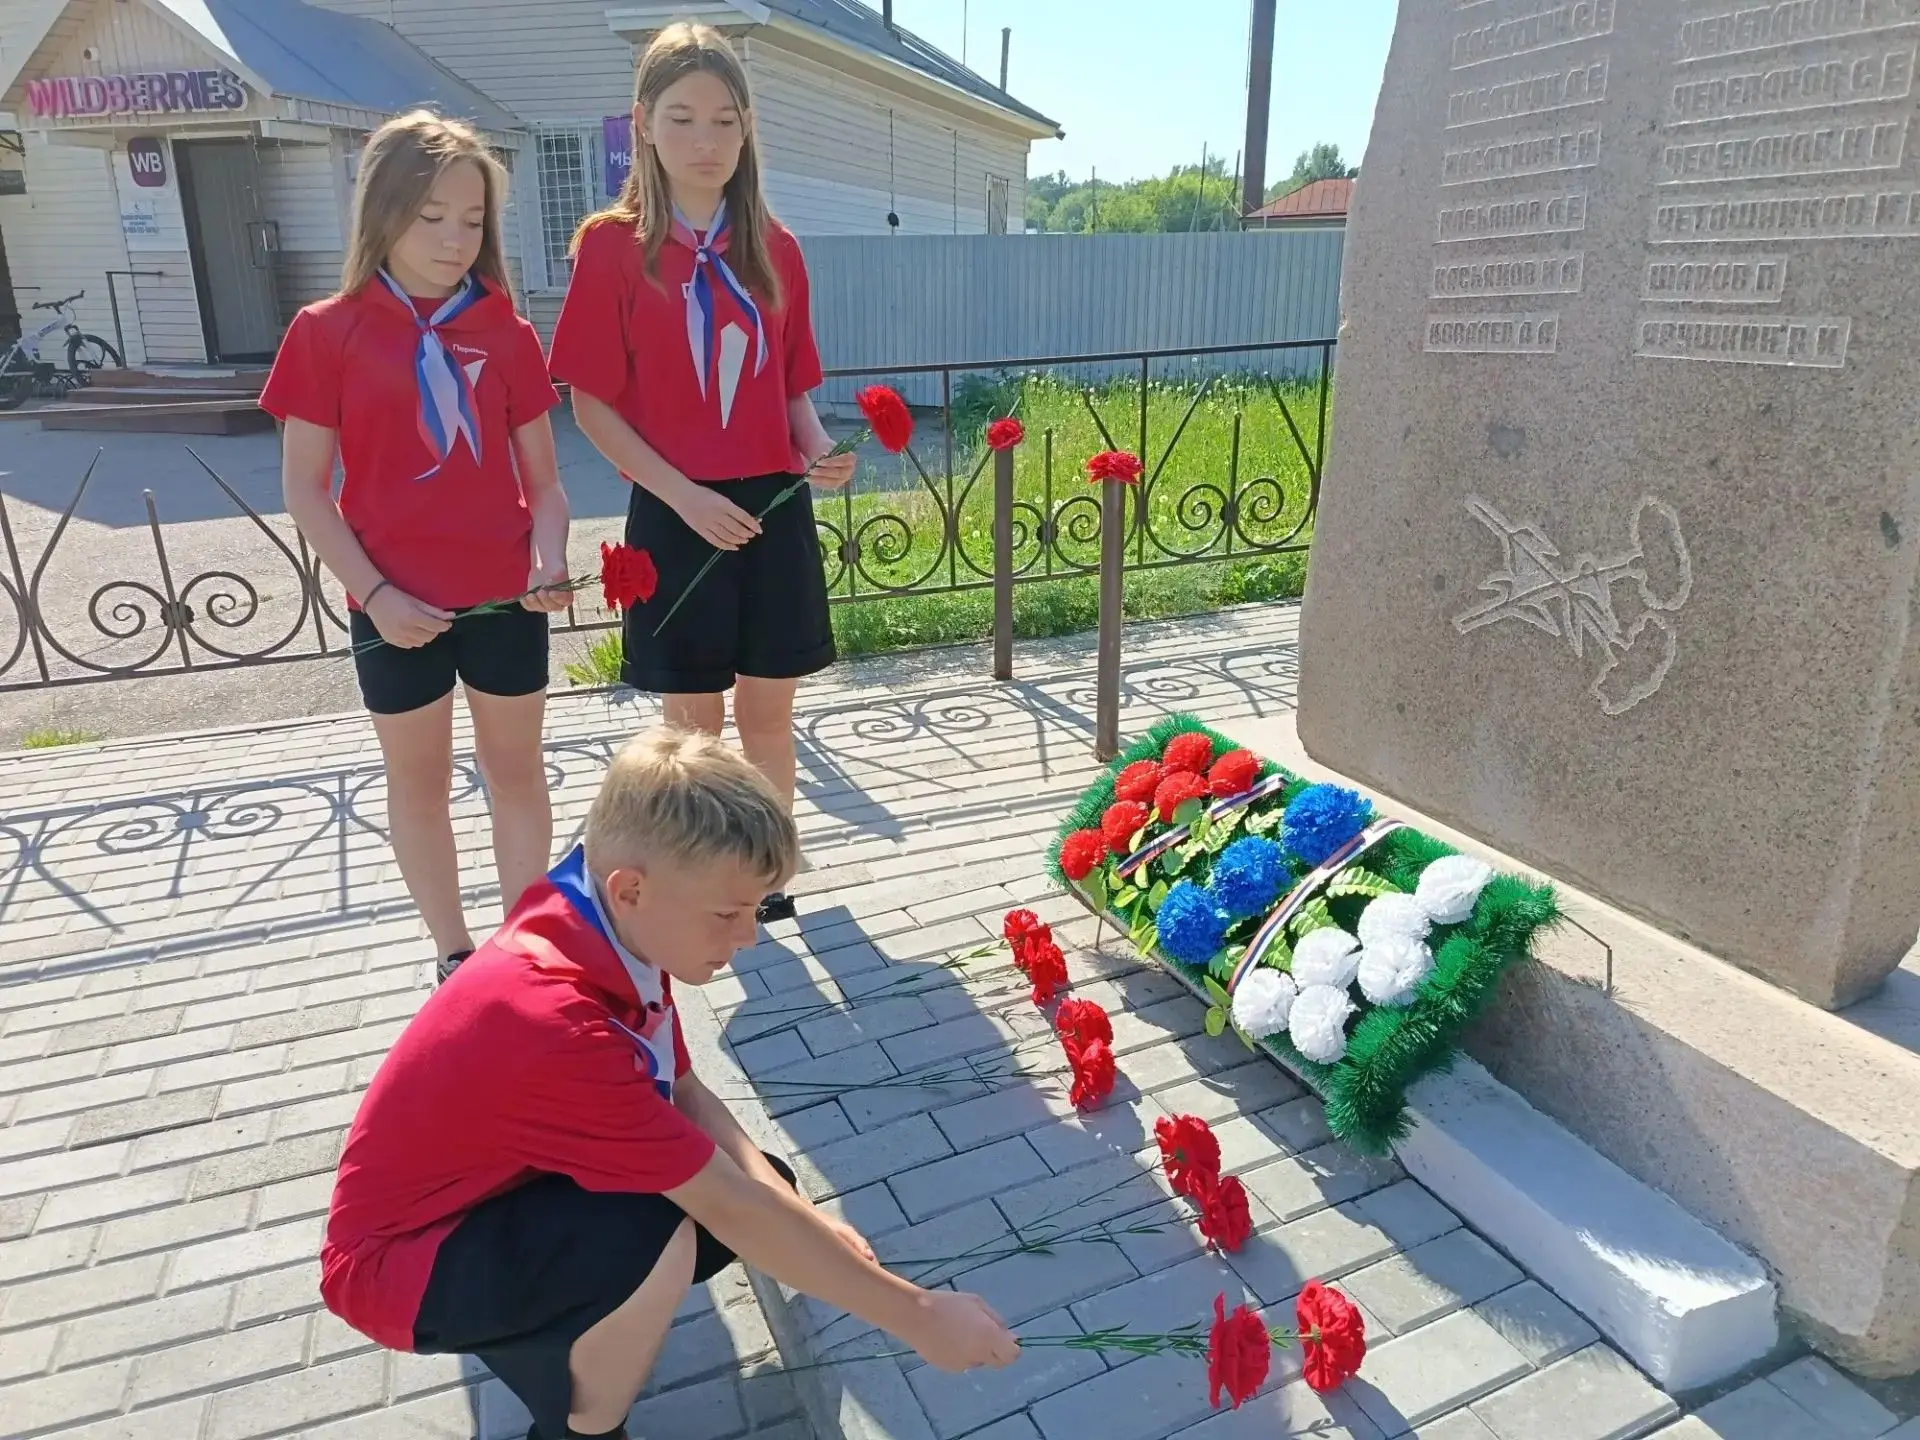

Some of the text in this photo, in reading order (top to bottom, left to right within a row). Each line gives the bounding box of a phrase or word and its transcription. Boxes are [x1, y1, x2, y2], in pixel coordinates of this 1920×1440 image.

[25, 69, 248, 119] WILDBERRIES
[130, 152, 162, 173] WB
[1663, 129, 1834, 174] ЧЕРЕПАНОВ
[1650, 263, 1748, 293] ШАРОВ
[1429, 320, 1513, 345] КОВАЛЕВ
